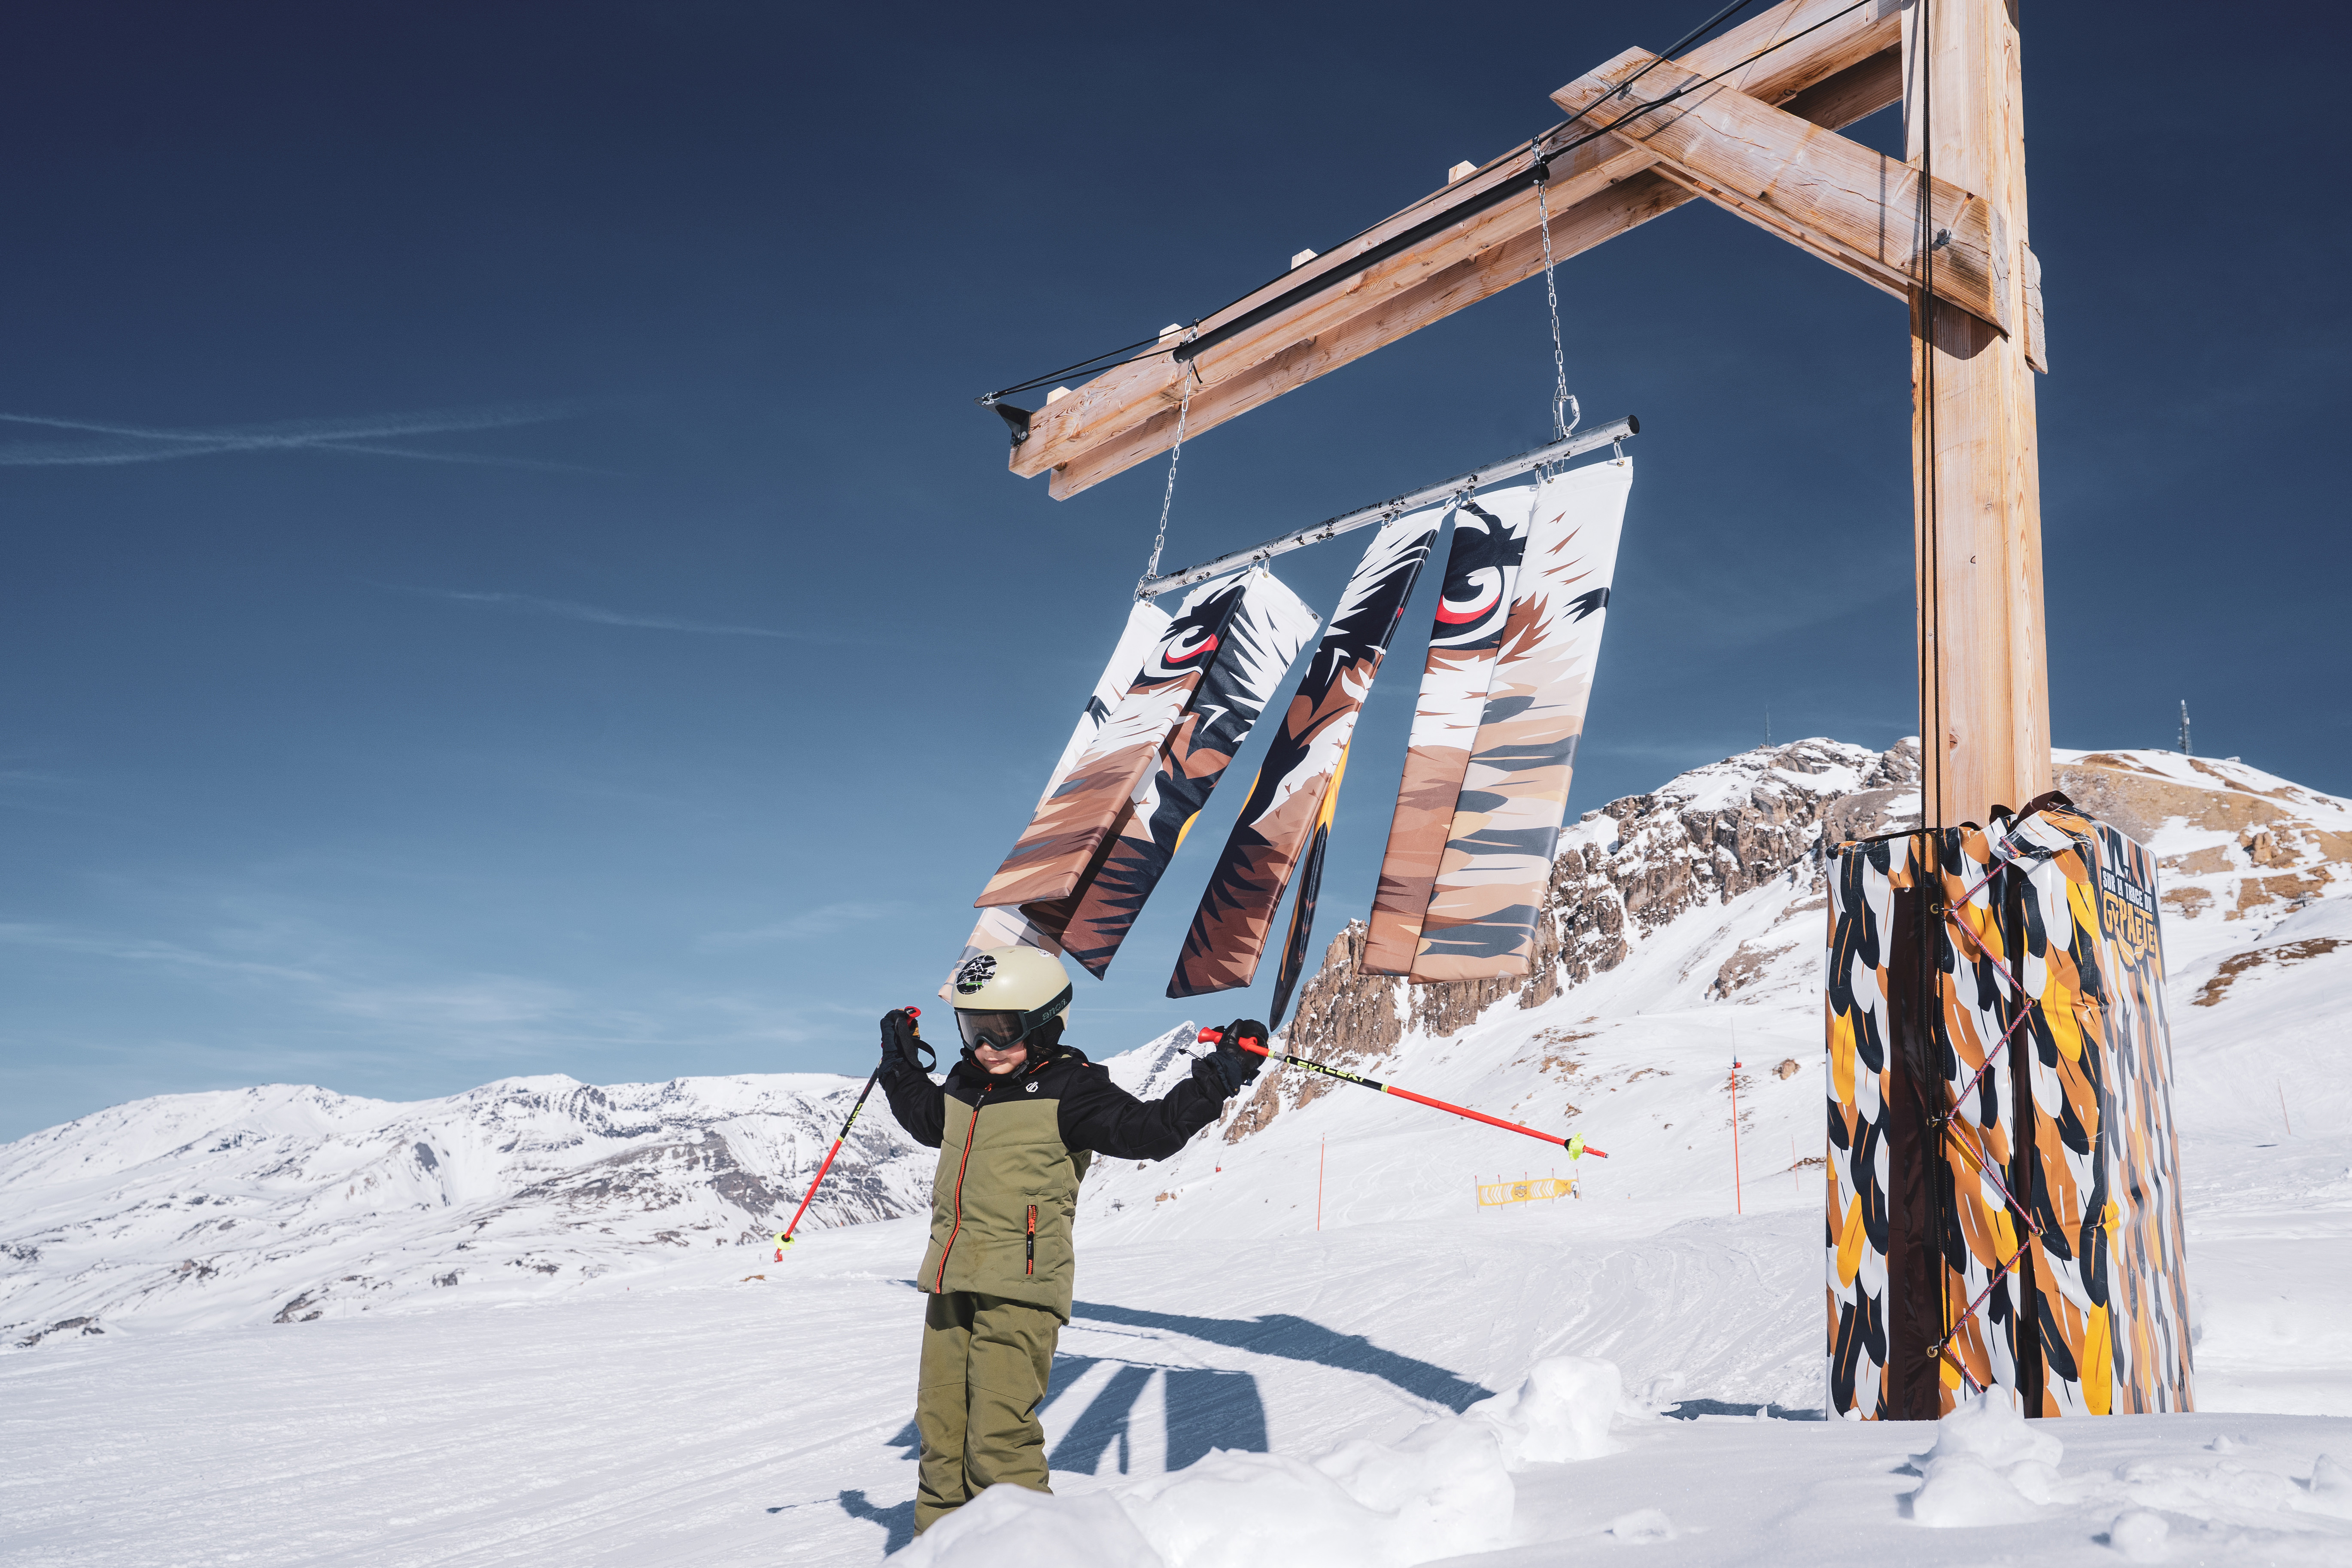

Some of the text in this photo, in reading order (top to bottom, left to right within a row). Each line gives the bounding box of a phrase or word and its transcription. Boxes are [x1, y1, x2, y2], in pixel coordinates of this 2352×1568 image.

[2103, 870, 2152, 913] SUR LA TRACE DU
